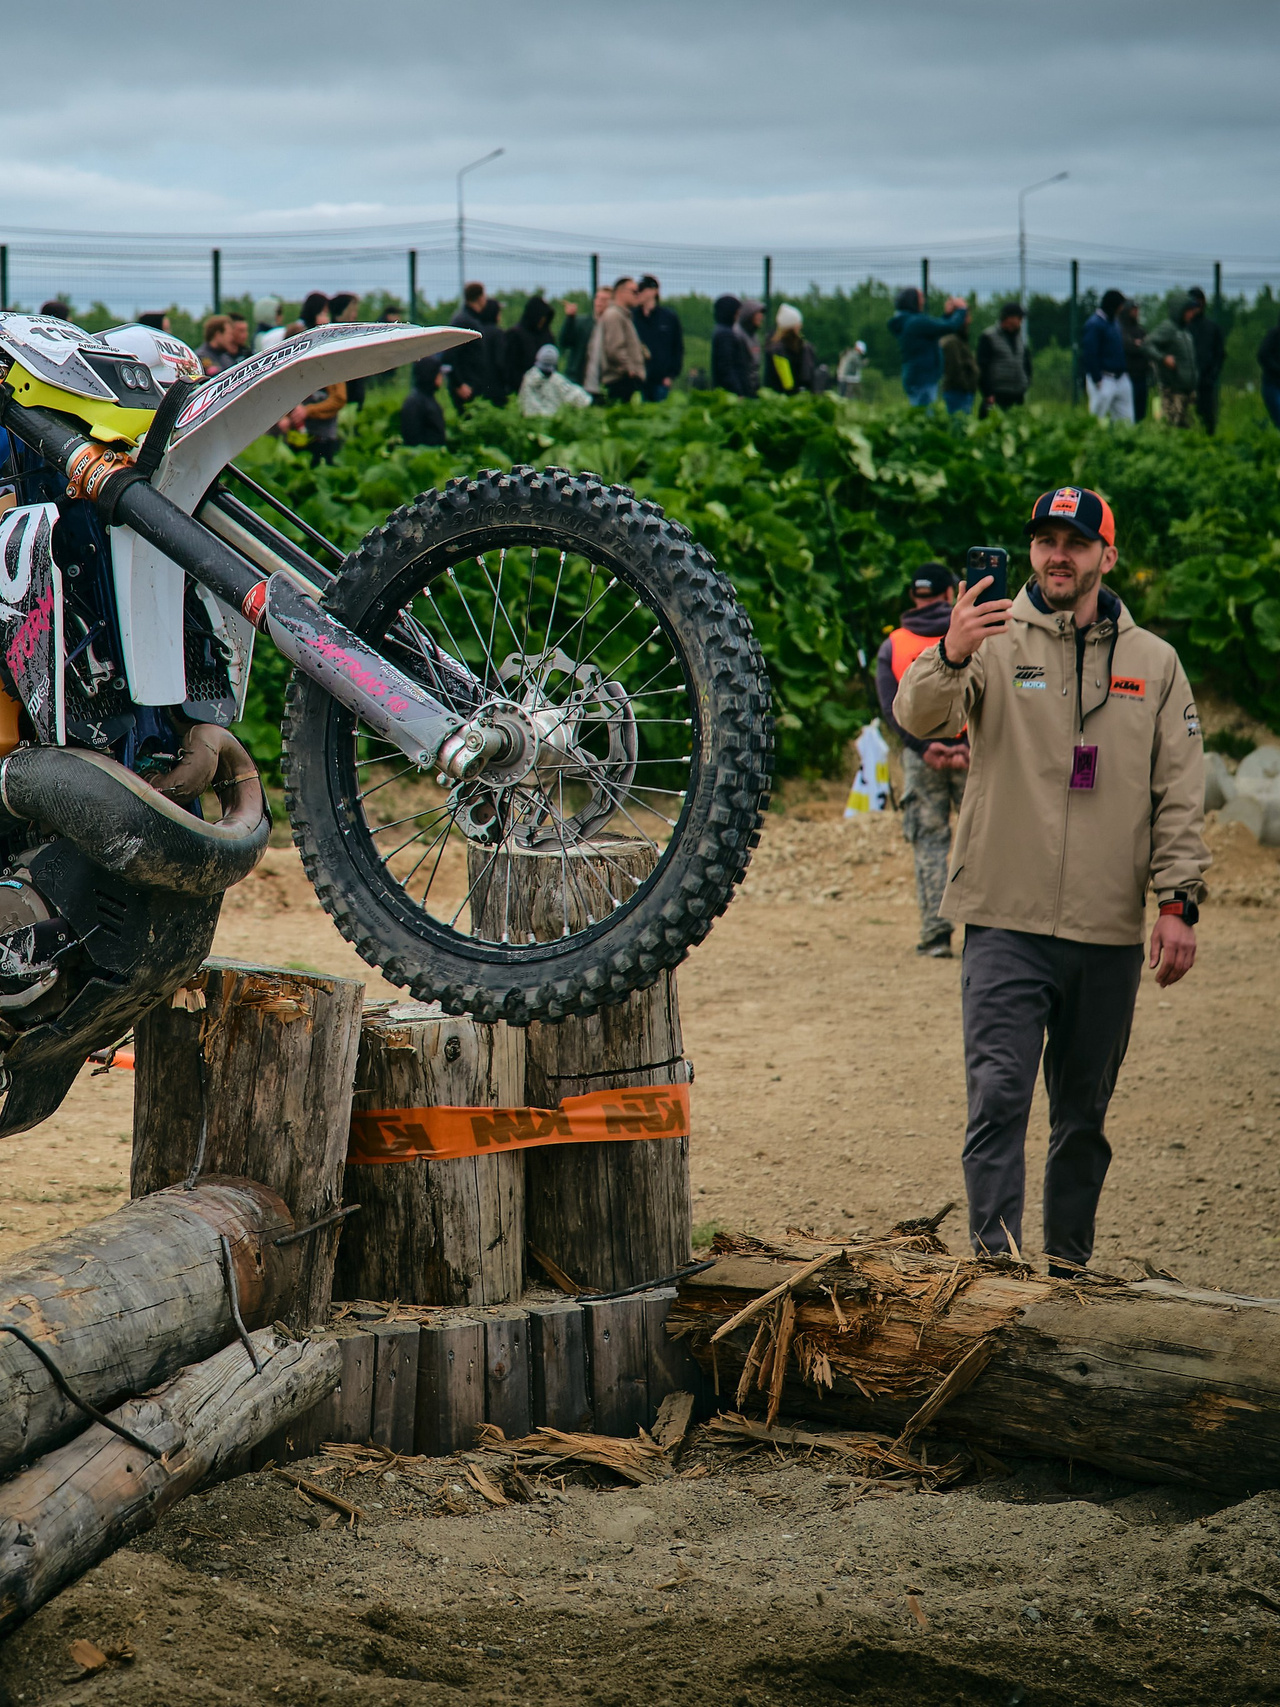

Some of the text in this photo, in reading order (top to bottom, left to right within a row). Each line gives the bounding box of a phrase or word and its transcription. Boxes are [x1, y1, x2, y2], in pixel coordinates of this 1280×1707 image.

[379, 665, 426, 703] FACTORY RACING
[1113, 681, 1140, 691] KTM
[92, 736, 109, 745] GRIP
